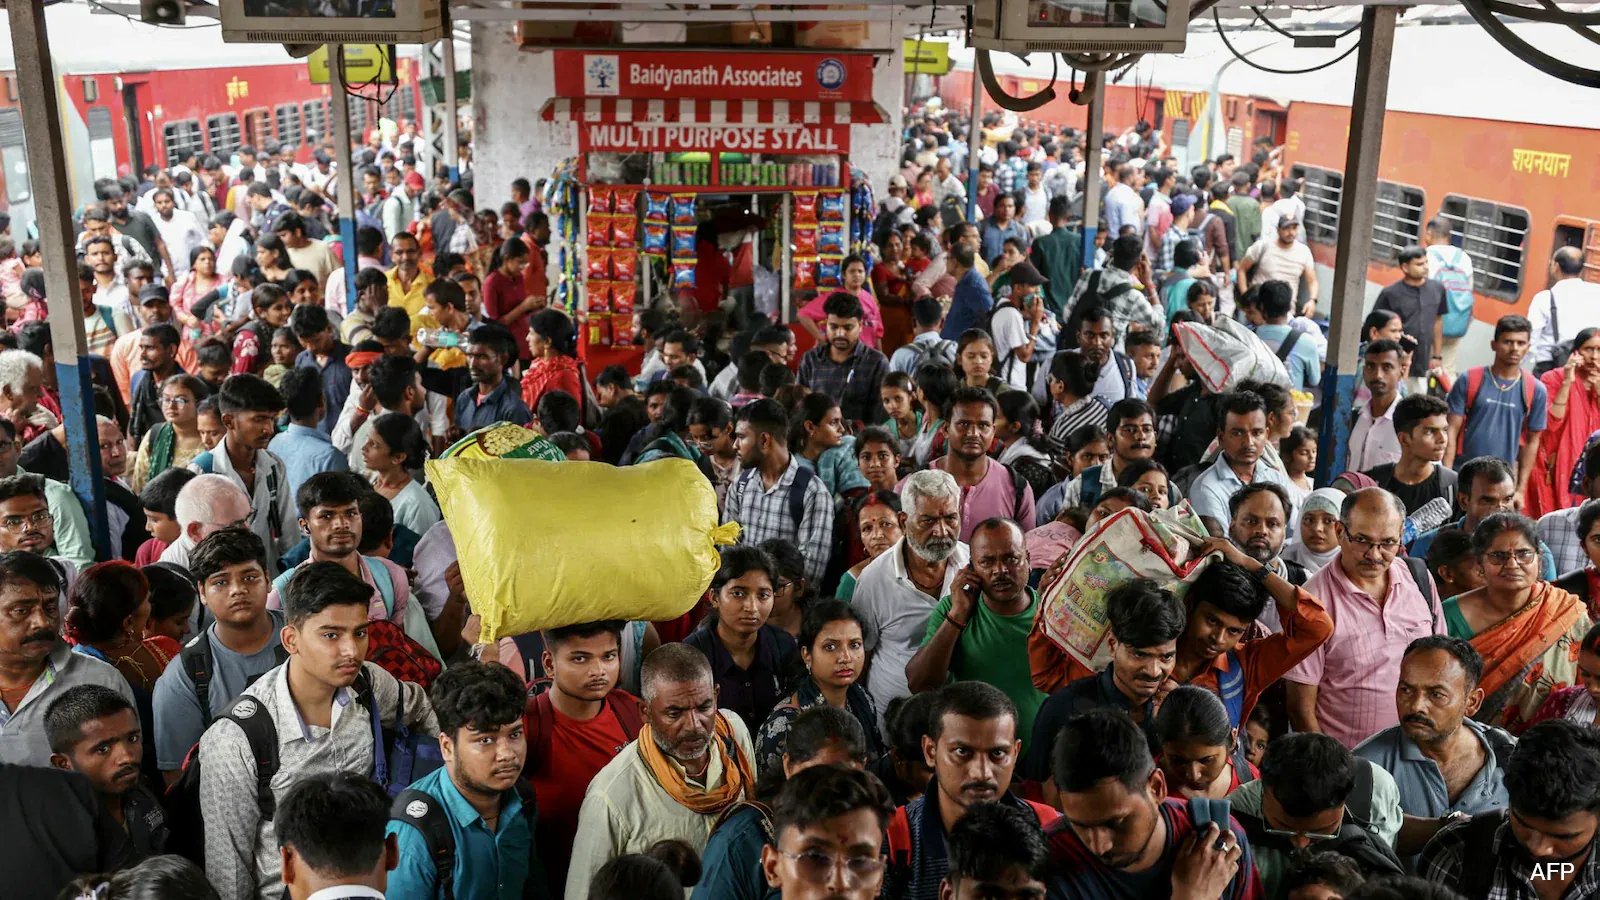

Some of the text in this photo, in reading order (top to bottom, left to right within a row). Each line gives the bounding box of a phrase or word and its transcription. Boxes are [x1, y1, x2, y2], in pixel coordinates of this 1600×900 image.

[630, 63, 802, 91] Baidyanath Associates
[590, 125, 839, 150] MULTI PURPOSE STALL
[1511, 148, 1572, 178] शयनयान
